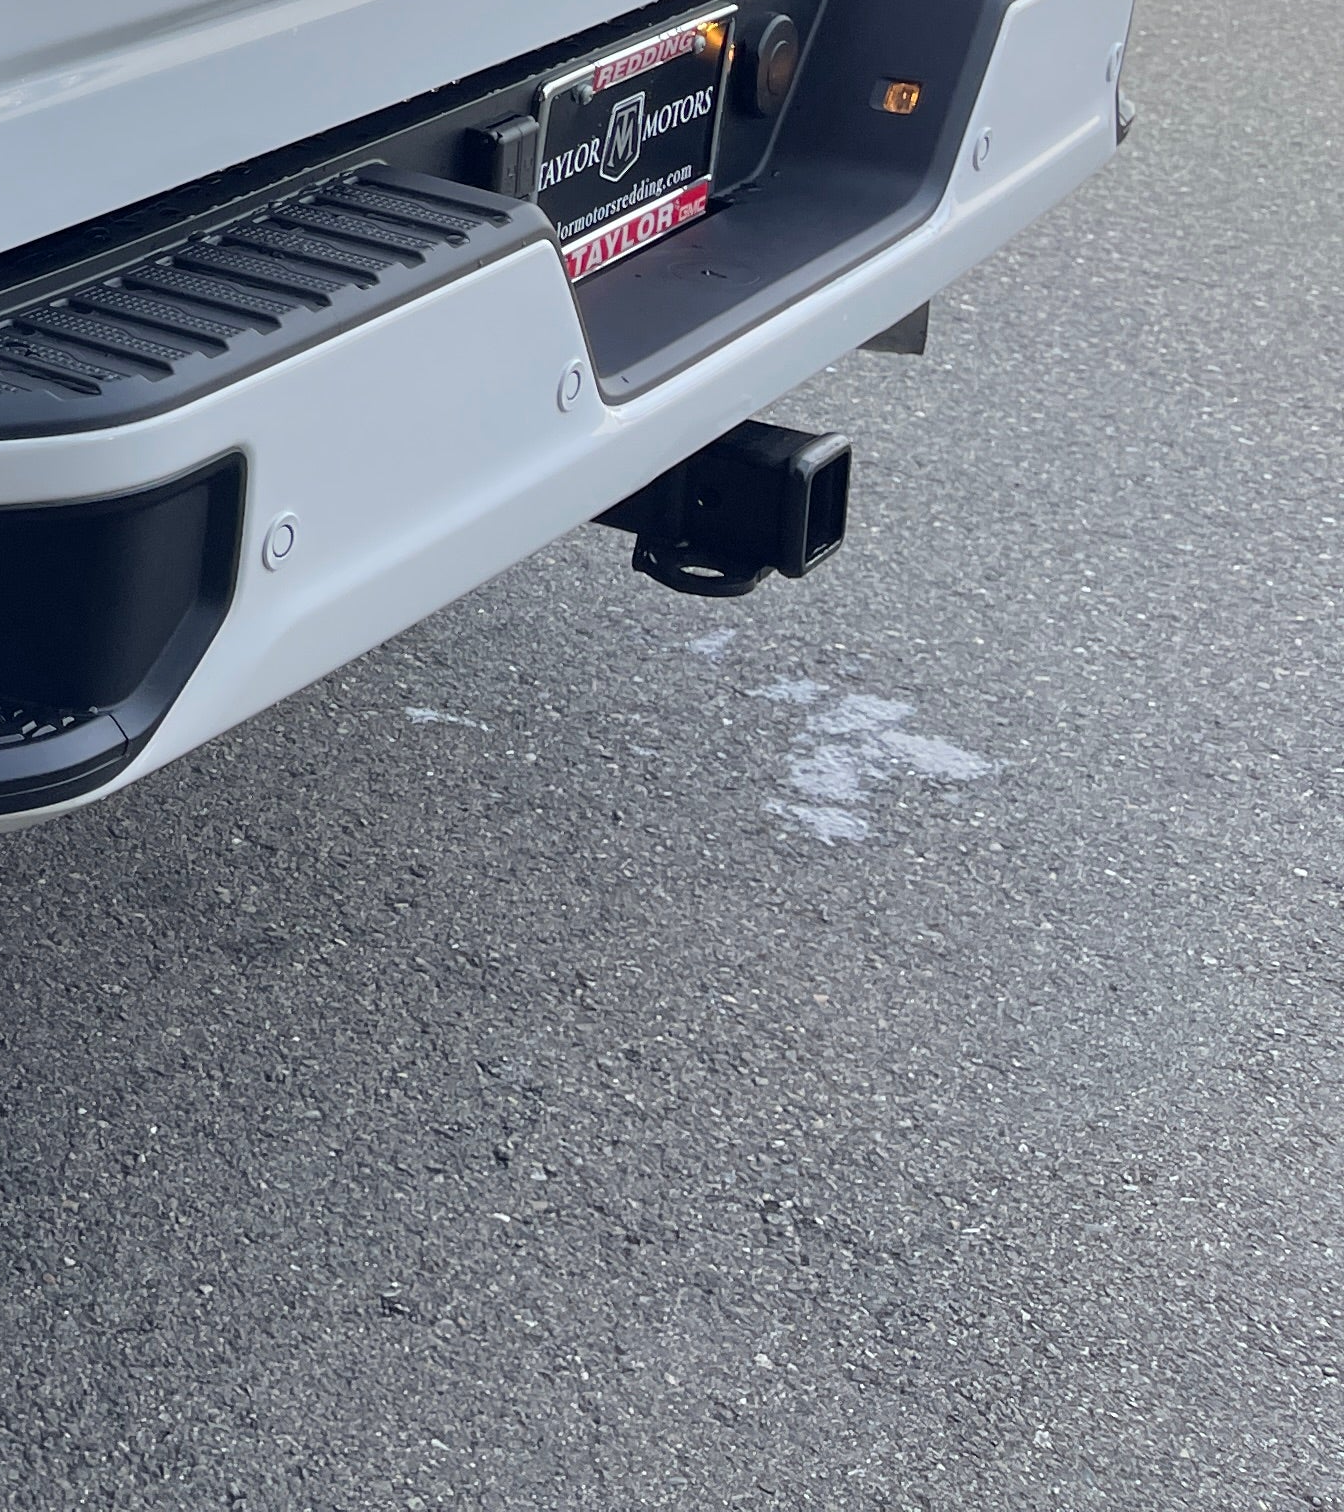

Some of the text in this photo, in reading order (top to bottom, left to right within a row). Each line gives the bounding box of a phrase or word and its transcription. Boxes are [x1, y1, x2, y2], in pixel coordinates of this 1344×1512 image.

[595, 29, 695, 90] REDDING
[538, 137, 600, 192] TAYLOR
[642, 85, 714, 142] MOTORS
[557, 163, 693, 241] lormotorsredding.com
[571, 199, 675, 277] TAYLOR
